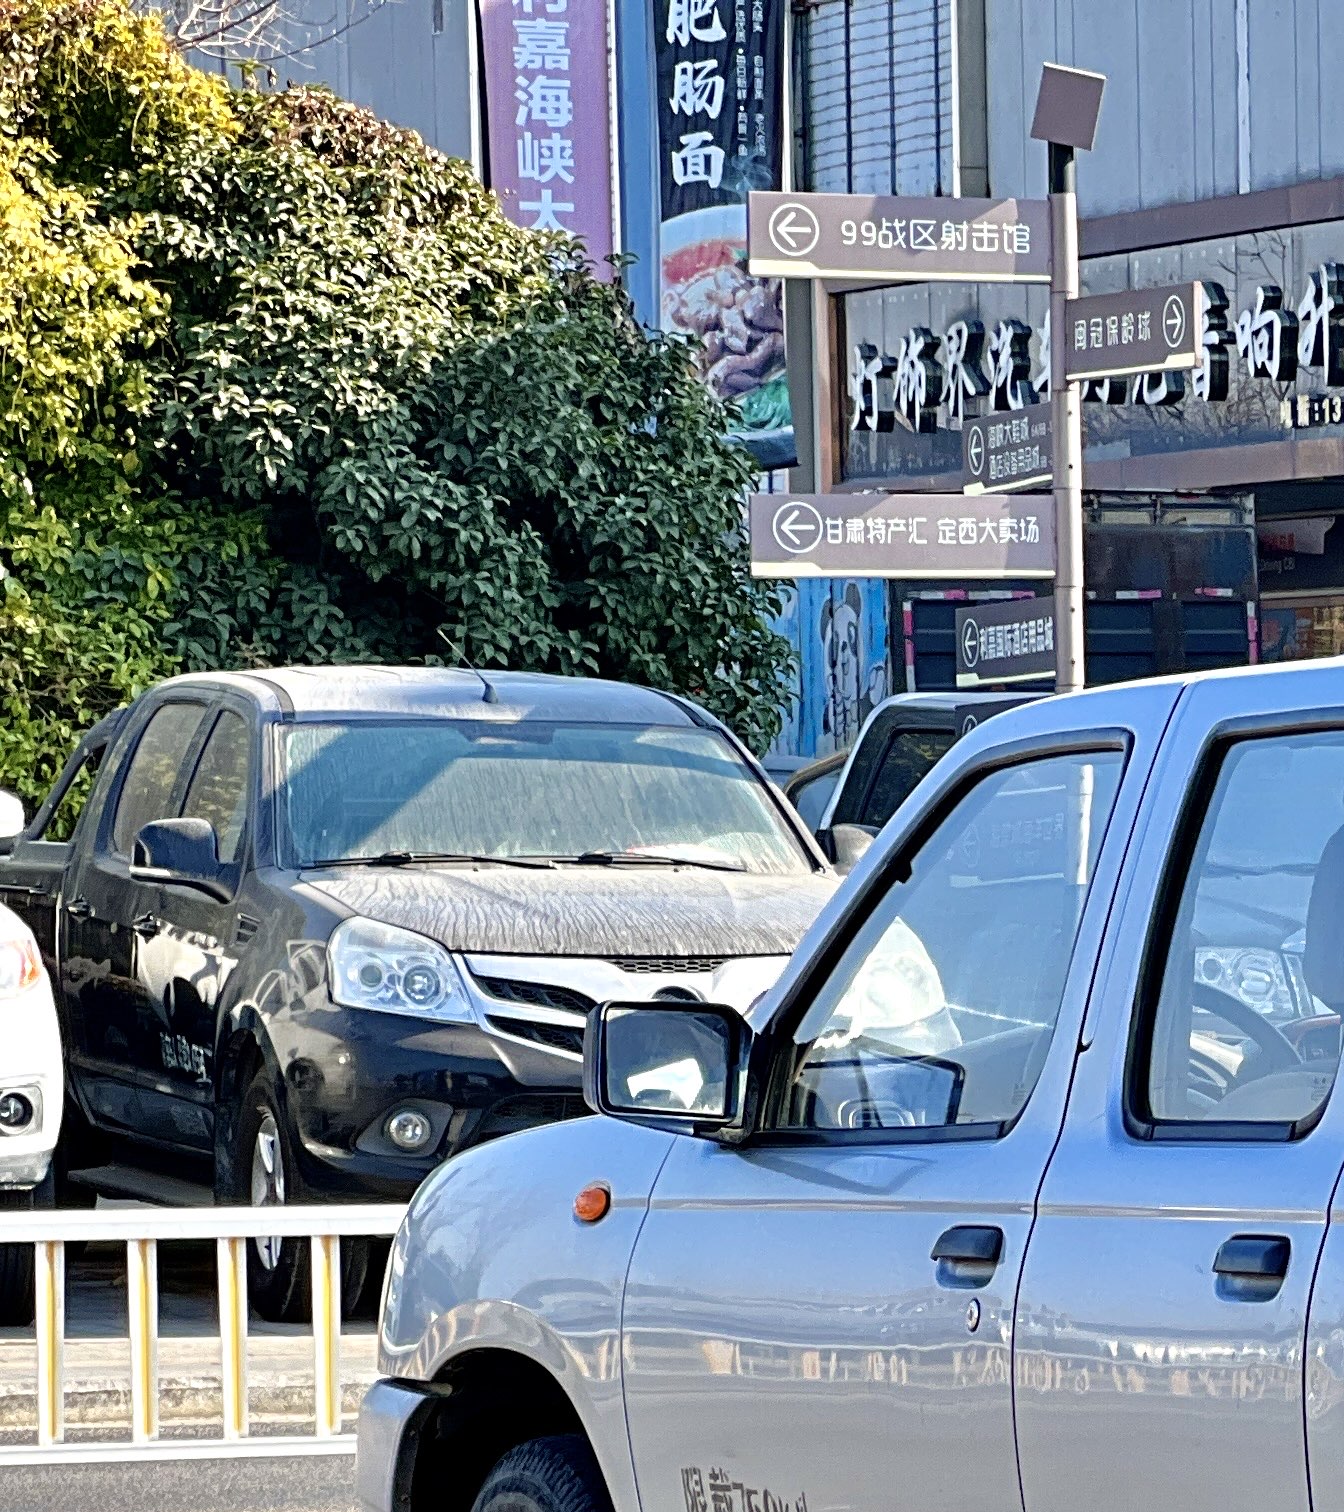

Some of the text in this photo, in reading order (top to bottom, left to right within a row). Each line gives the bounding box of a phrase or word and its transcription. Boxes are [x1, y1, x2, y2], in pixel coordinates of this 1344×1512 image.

[512, 0, 575, 238] 嘉海峡大
[840, 217, 1031, 254] 99战区射击馆
[1074, 310, 1152, 351] 闽冠保龄球
[825, 516, 1040, 545] 甘肃特产汇 定西大卖场
